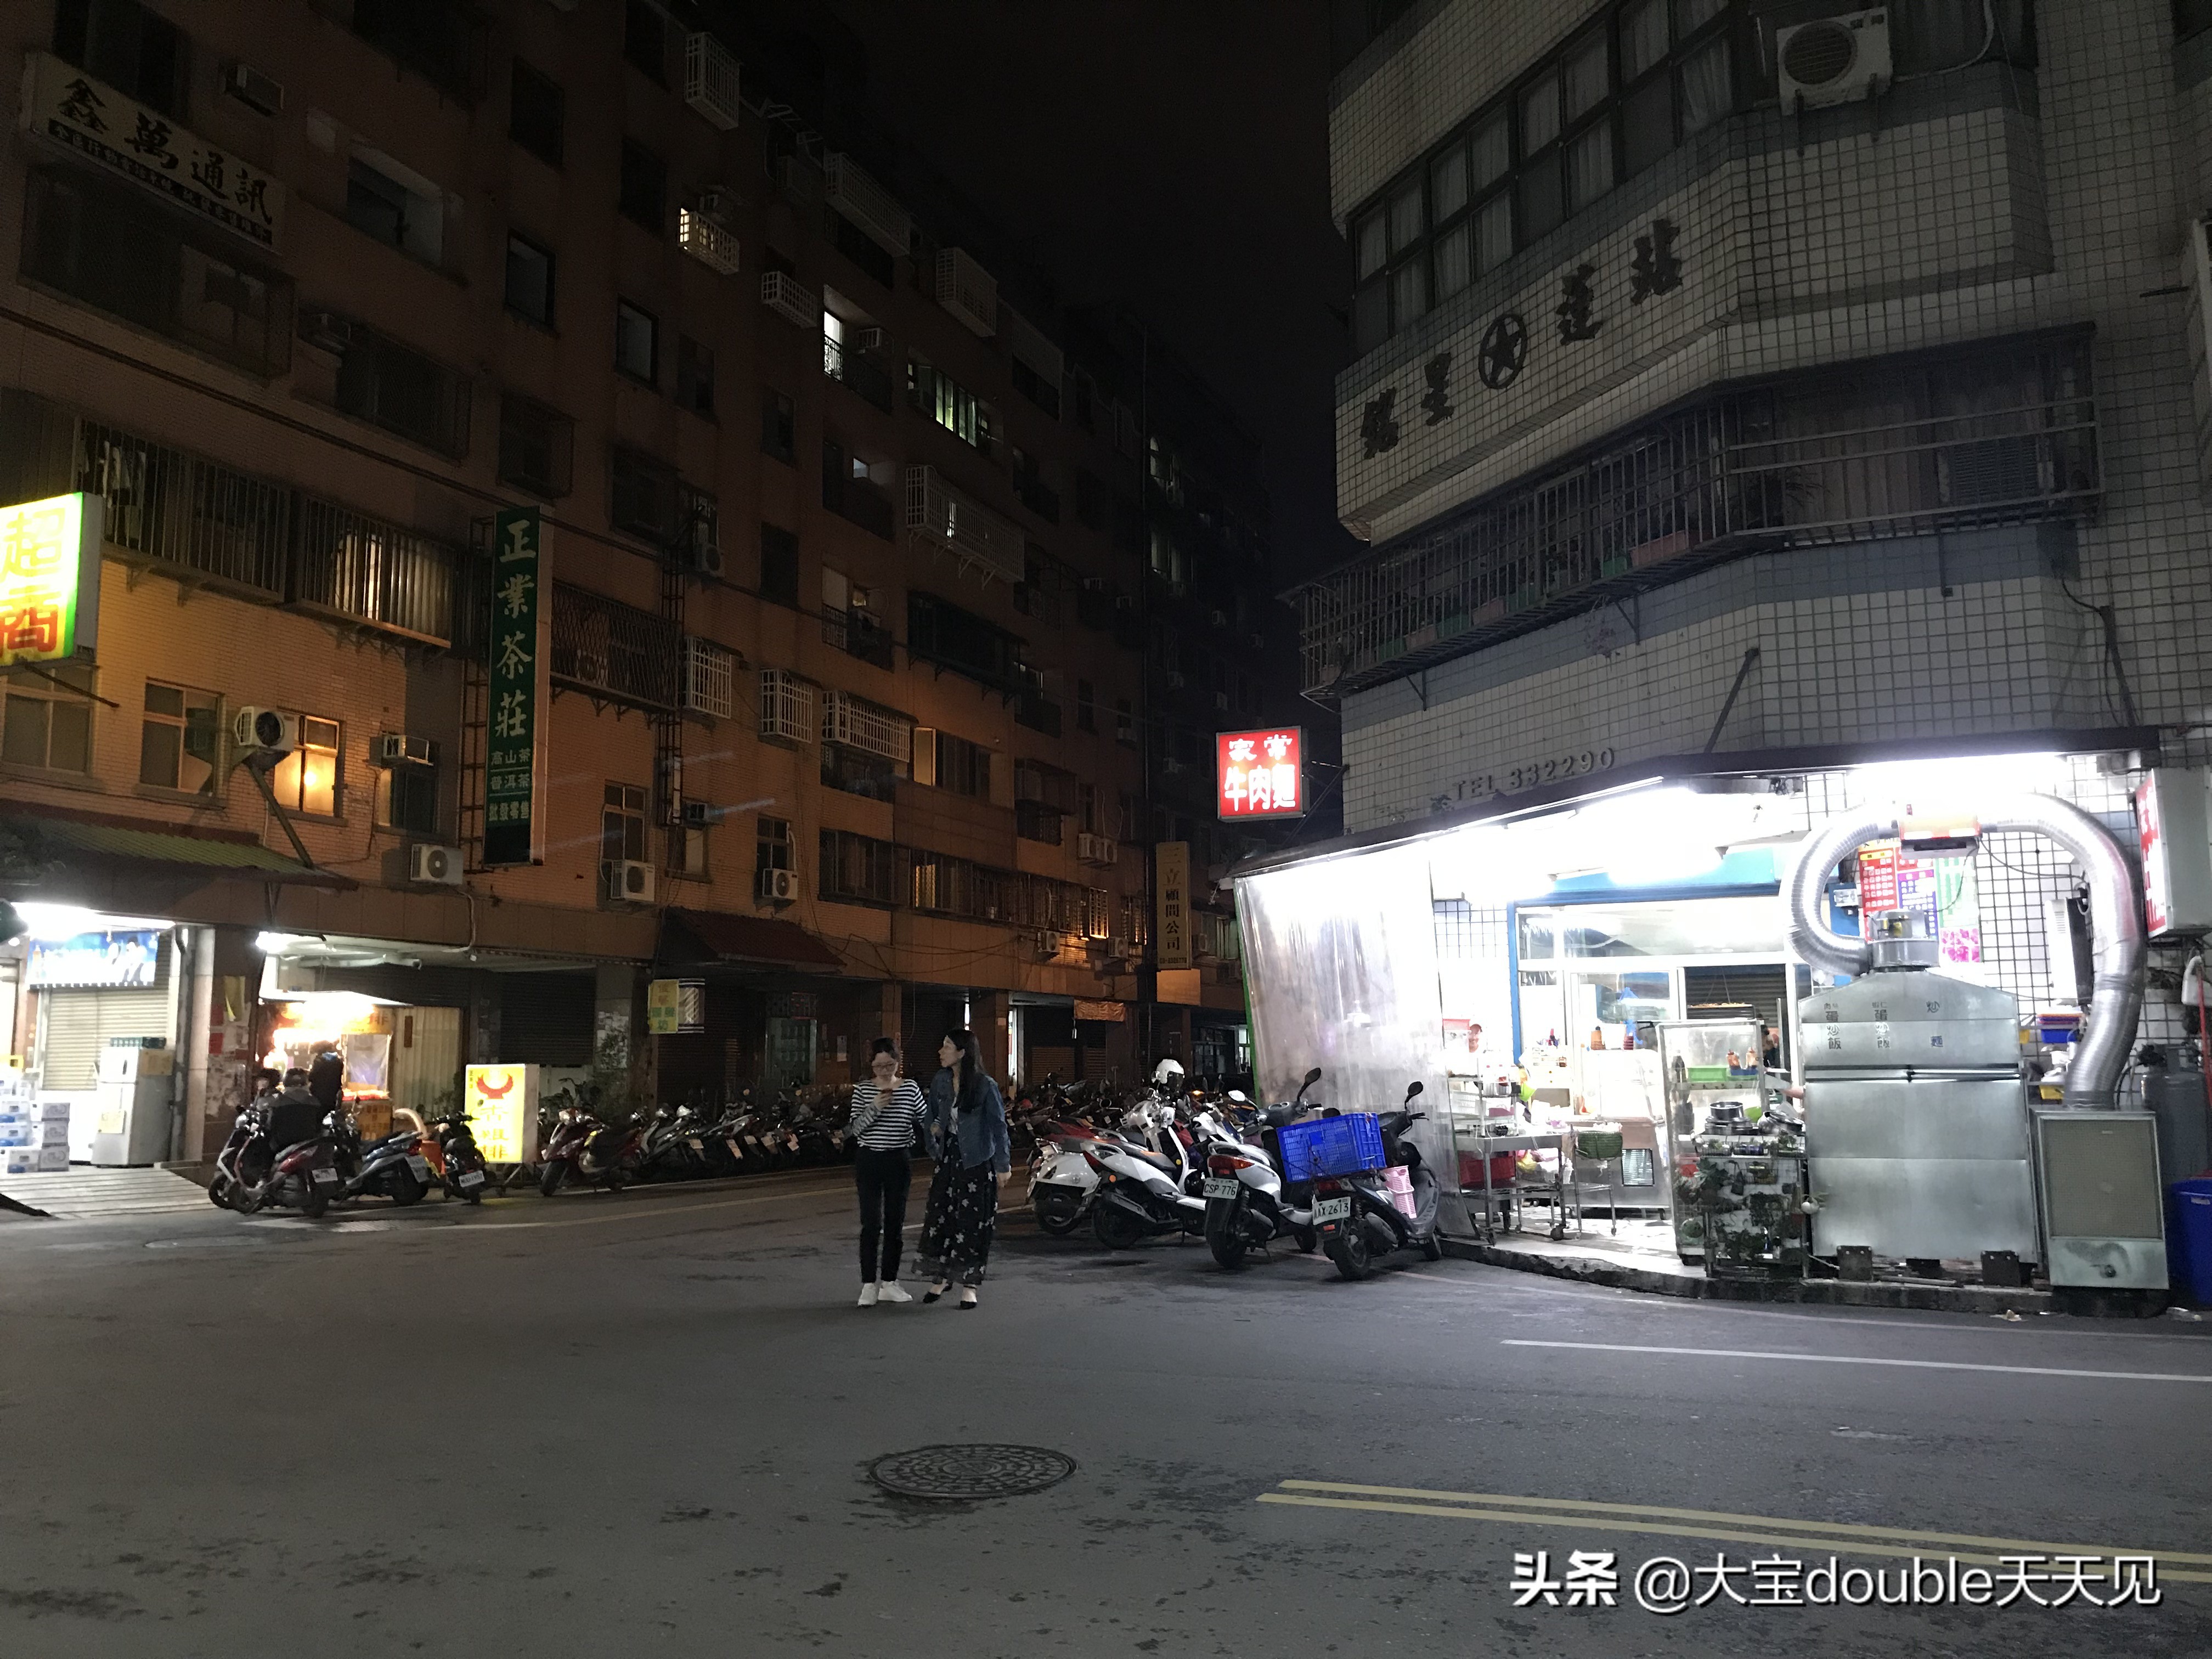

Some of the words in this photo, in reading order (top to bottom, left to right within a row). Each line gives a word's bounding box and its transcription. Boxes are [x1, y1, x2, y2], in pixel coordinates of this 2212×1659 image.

[58, 78, 273, 225] 鑫萬通訊
[495, 519, 537, 738] 正業茶莊
[491, 747, 531, 766] 高山茶
[1228, 733, 1293, 762] 家常
[490, 773, 531, 791] 普洱茶
[1224, 763, 1296, 812] 牛肉麵
[1453, 775, 1499, 801] TEL
[1510, 748, 1615, 790] 332290
[1163, 847, 1181, 950] 三立顧問公司
